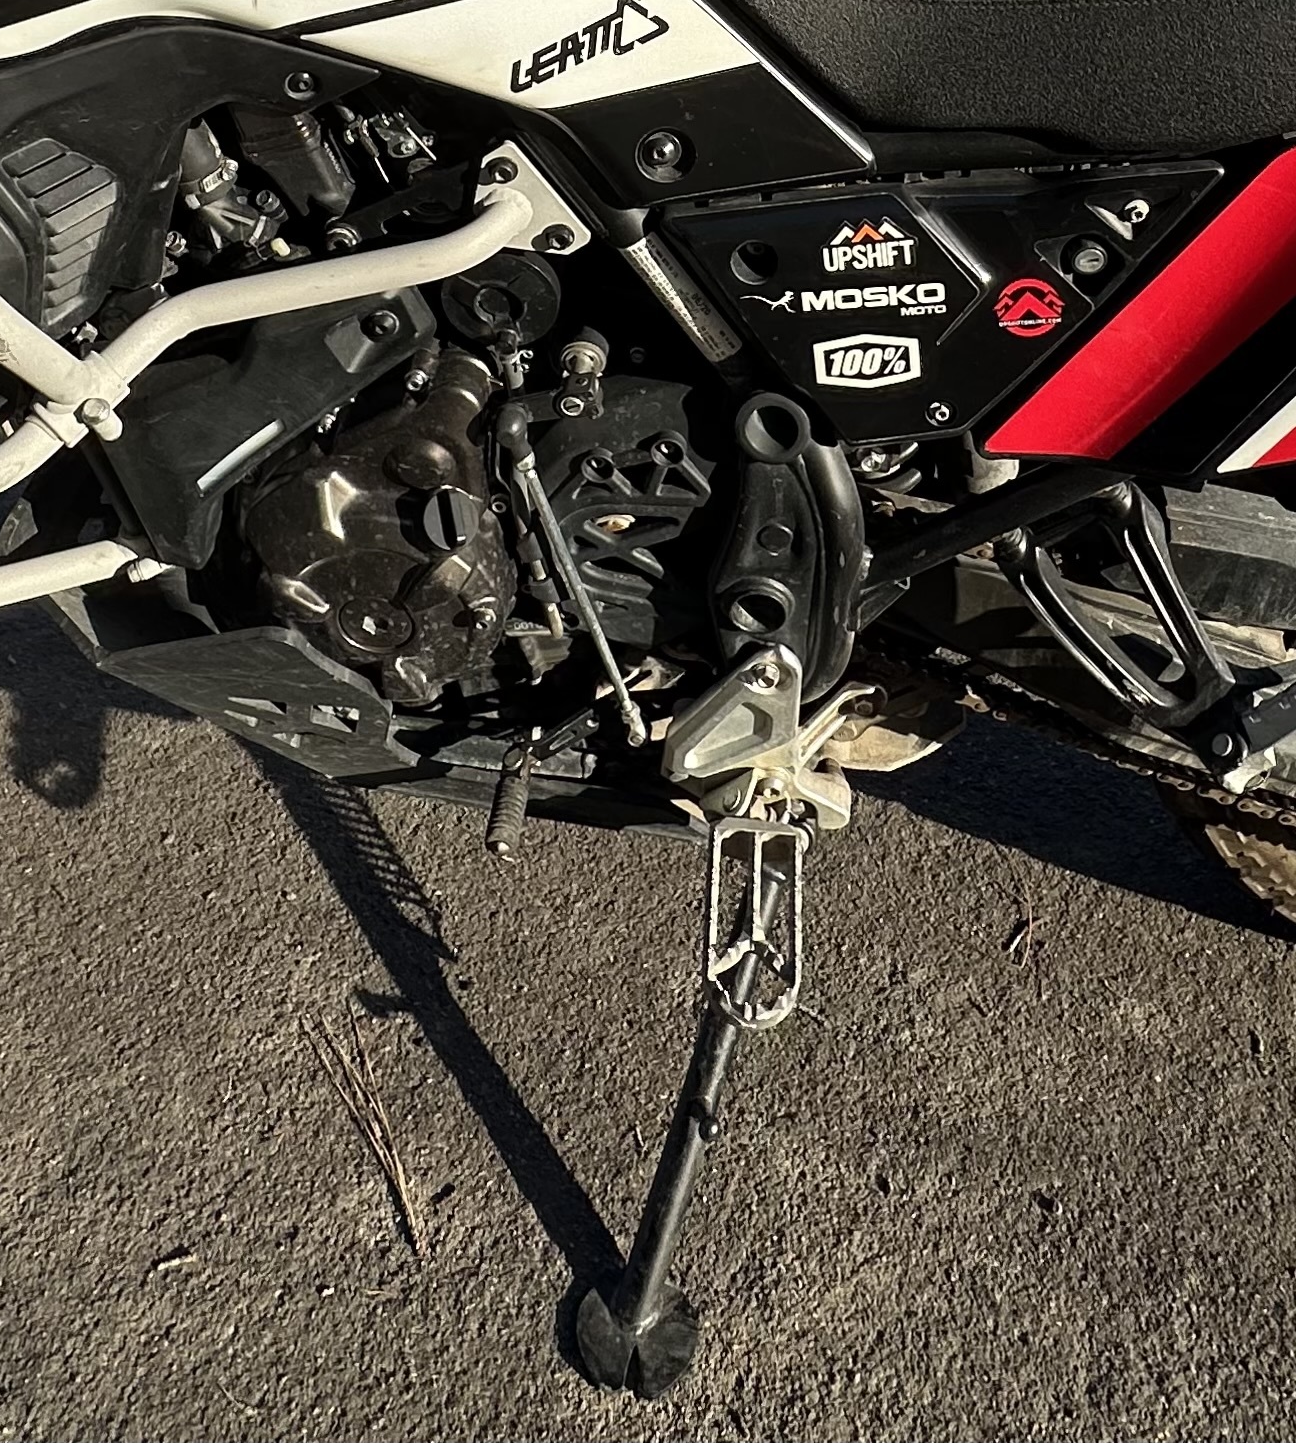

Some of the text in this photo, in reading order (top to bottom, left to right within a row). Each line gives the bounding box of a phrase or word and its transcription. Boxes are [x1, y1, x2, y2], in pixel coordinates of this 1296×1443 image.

[822, 240, 915, 272] UPSHIFT
[801, 283, 946, 312] MOSKO
[900, 304, 947, 317] MOTO
[829, 346, 907, 377] 100%
